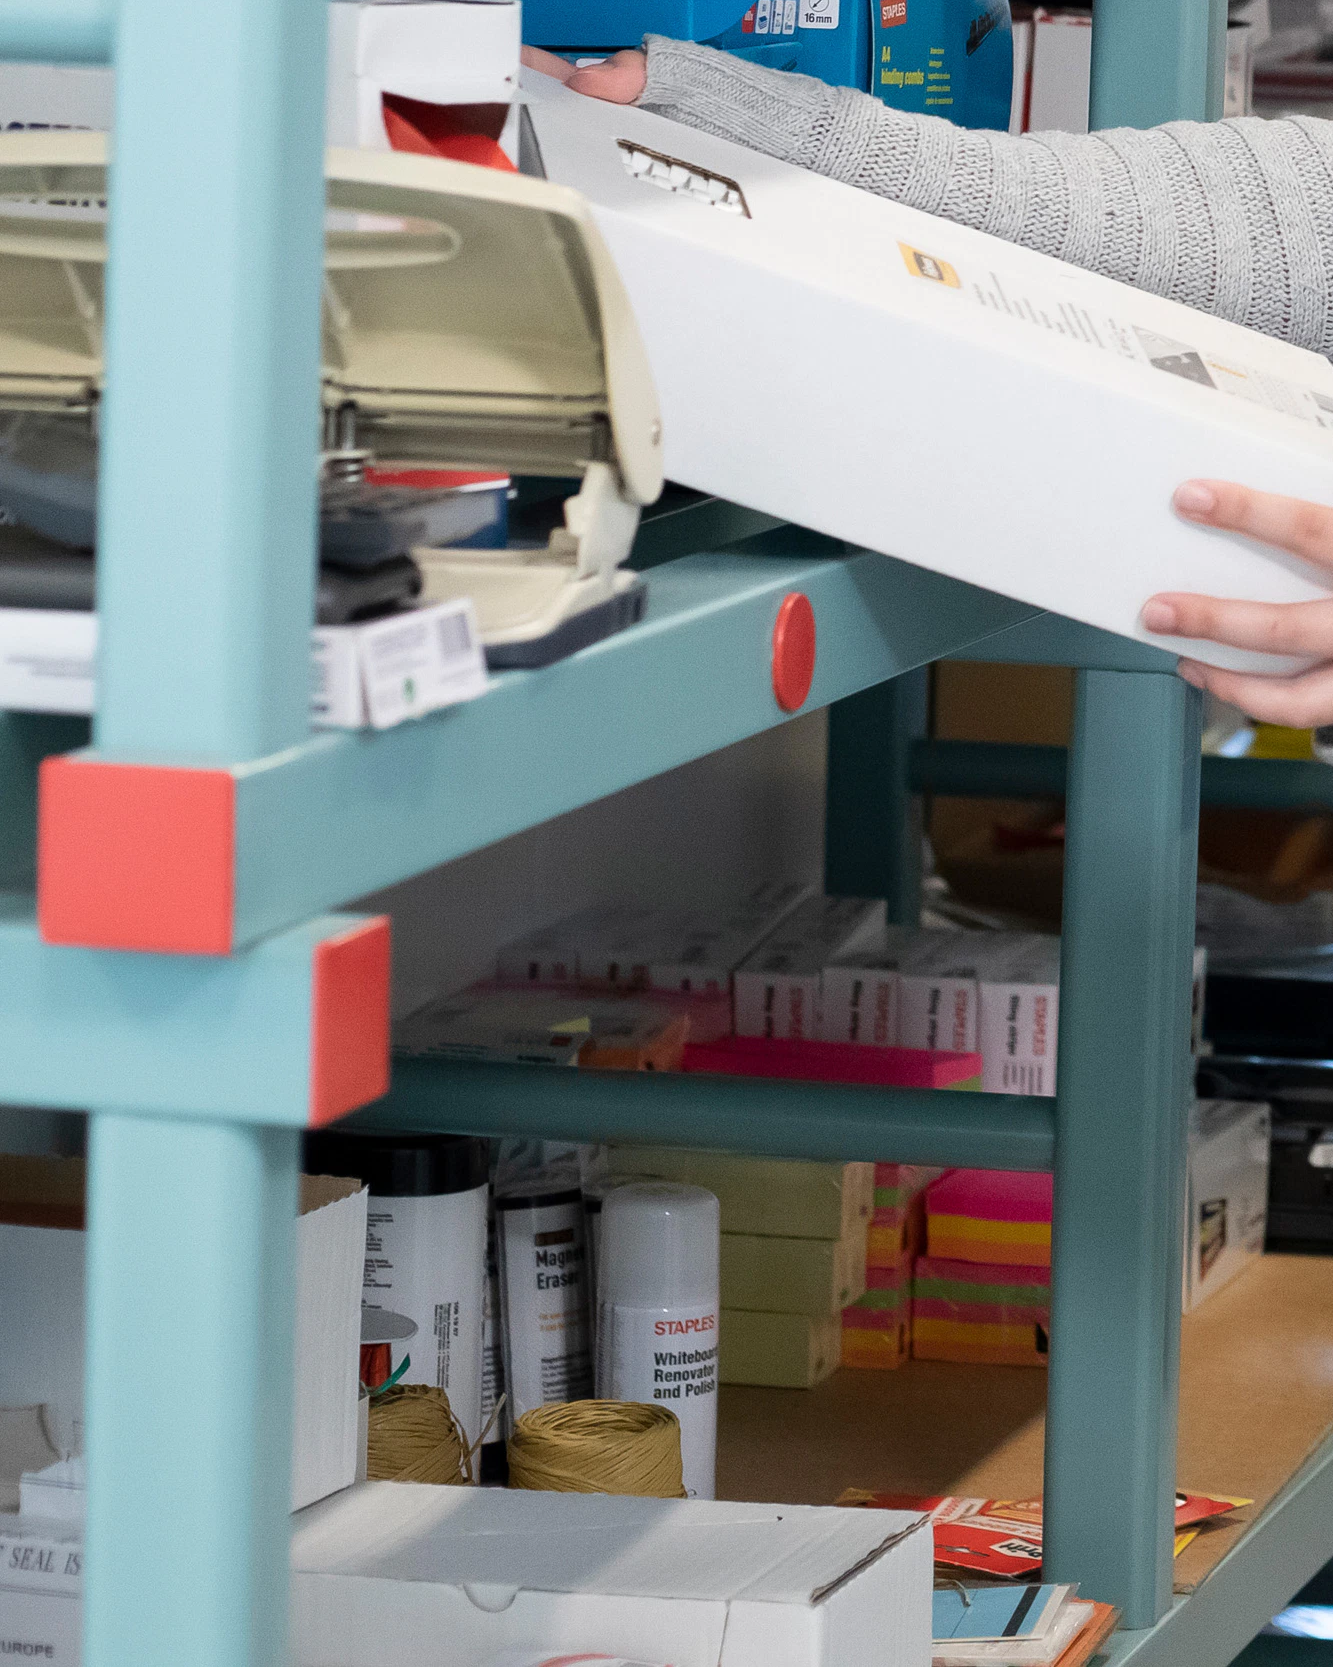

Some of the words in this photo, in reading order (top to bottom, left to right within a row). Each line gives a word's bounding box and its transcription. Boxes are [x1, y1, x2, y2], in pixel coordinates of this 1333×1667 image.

[882, 2, 906, 20] STAPLES
[655, 1315, 715, 1336] STAPLES
[653, 1385, 681, 1399] and
[9, 1547, 54, 1573] SEAL
[0, 1640, 53, 1659] UROPE
